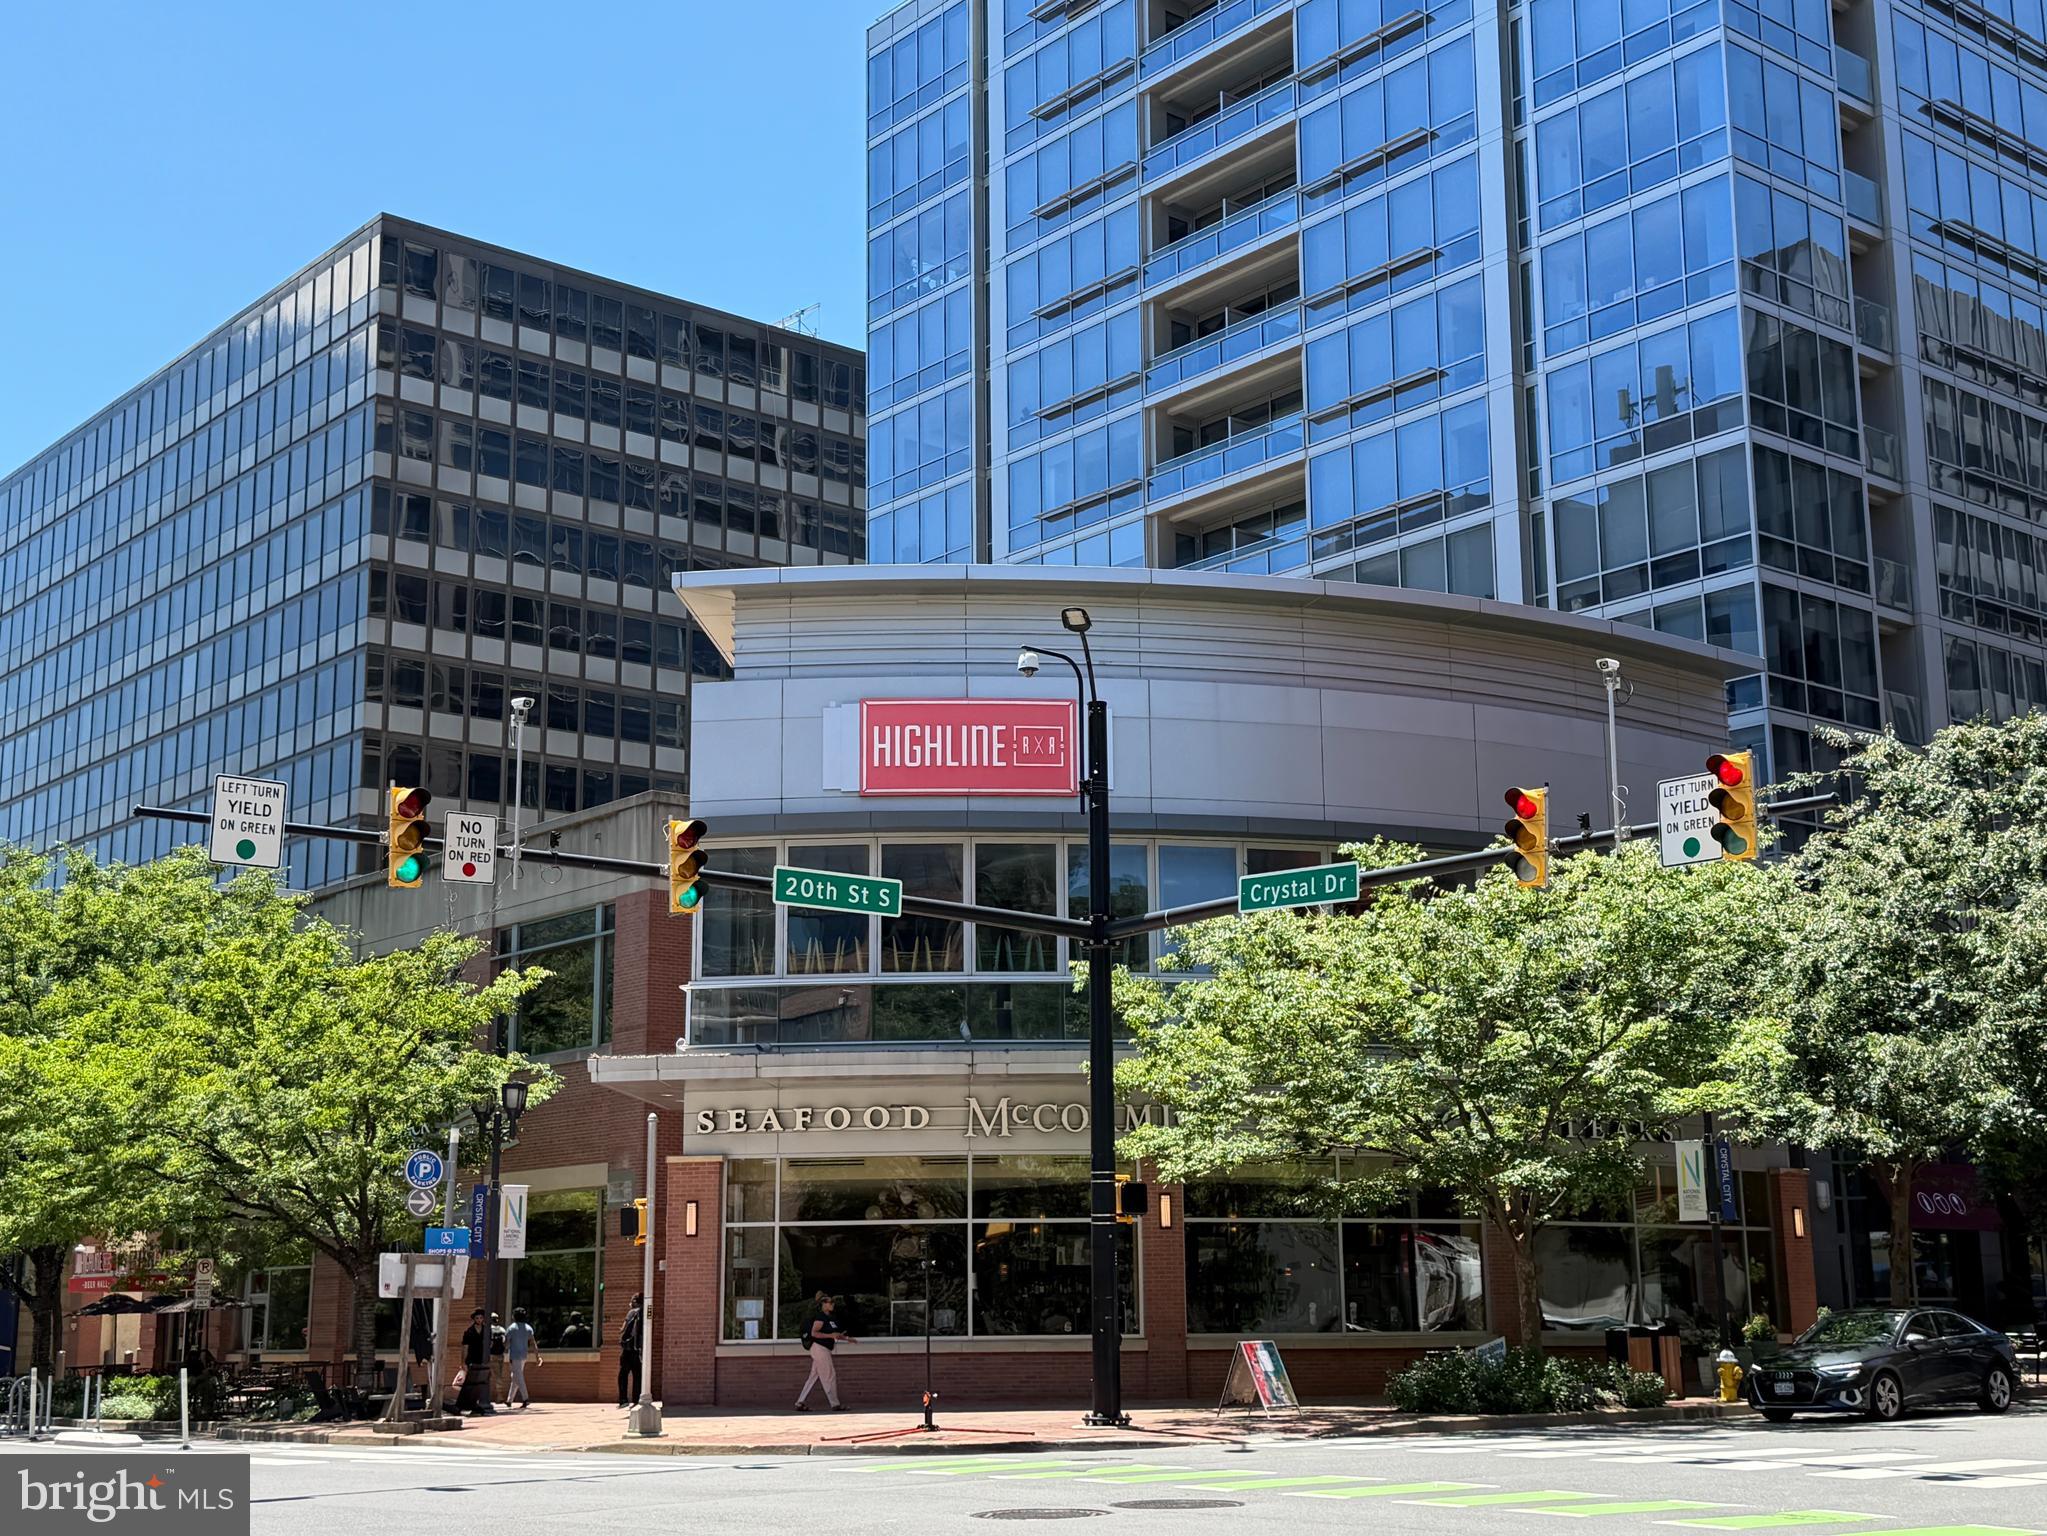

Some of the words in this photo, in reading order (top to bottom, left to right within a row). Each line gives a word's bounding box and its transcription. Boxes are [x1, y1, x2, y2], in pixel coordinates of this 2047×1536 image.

[873, 725, 1007, 767] HIGHLINE
[222, 781, 248, 794] LEFT
[250, 784, 280, 798] TURN
[1664, 784, 1686, 798] LEFT
[1688, 779, 1714, 793] TURN
[228, 800, 272, 818] YIELD
[1670, 798, 1709, 816] YIELD
[220, 819, 235, 831] ON
[240, 821, 276, 836] GREEN
[460, 820, 482, 834] NO
[1666, 822, 1679, 834] ON
[1684, 816, 1714, 831] GREEN
[456, 836, 486, 849] TURN
[448, 850, 464, 861] ON
[470, 852, 491, 864] RED
[786, 877, 837, 900] 20th
[848, 884, 869, 904] St
[878, 888, 890, 907] S
[1250, 876, 1316, 905] Crystal
[1324, 874, 1346, 894] Dr
[696, 1106, 930, 1134] SEAFOOD
[414, 1154, 436, 1163] PUBLIC
[1720, 1148, 1731, 1182] CRYSTAL
[420, 1163, 432, 1178] P
[410, 1176, 437, 1186] PARKING
[1722, 1184, 1732, 1204] CITY
[474, 1194, 484, 1225] CRYSTAL
[474, 1226, 482, 1244] CITY
